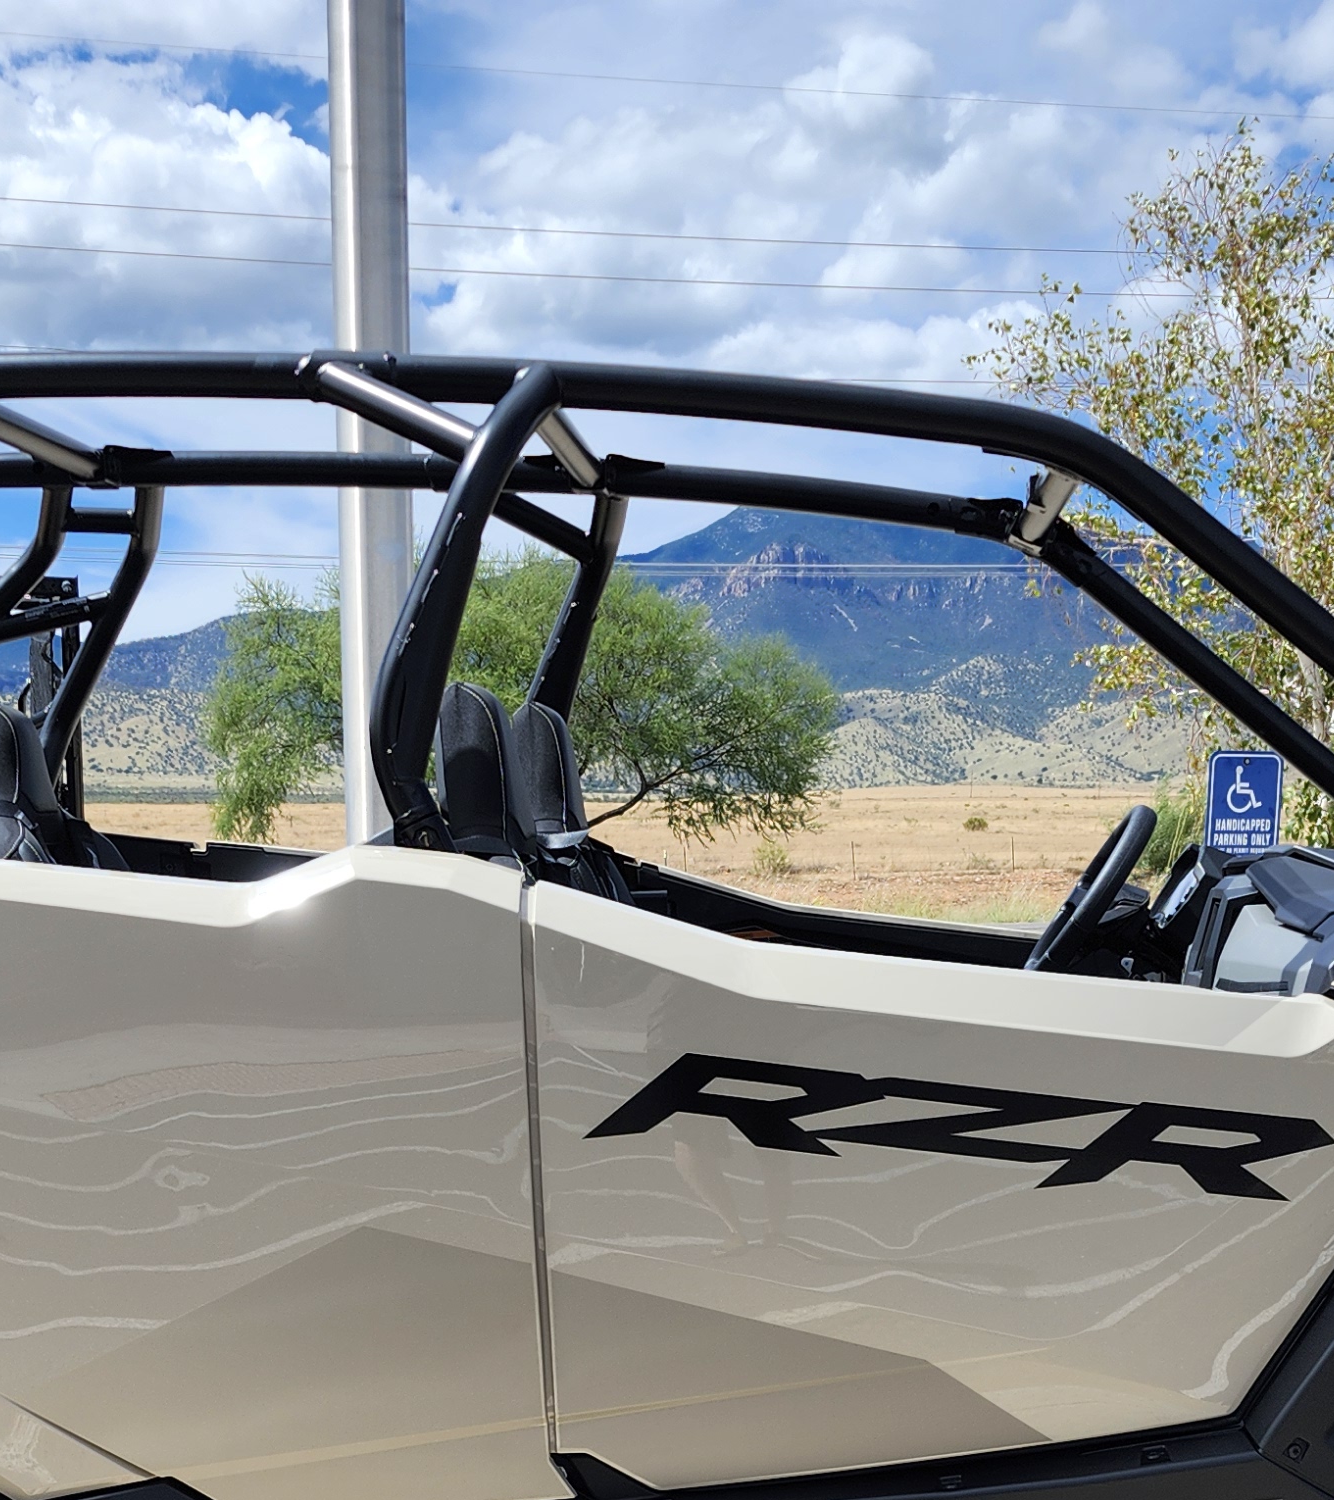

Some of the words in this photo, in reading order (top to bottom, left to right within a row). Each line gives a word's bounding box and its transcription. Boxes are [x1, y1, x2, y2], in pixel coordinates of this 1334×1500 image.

[1215, 818, 1271, 831] HANDICAPPED
[1213, 832, 1248, 846] PARKING
[1250, 832, 1271, 846] ONLY
